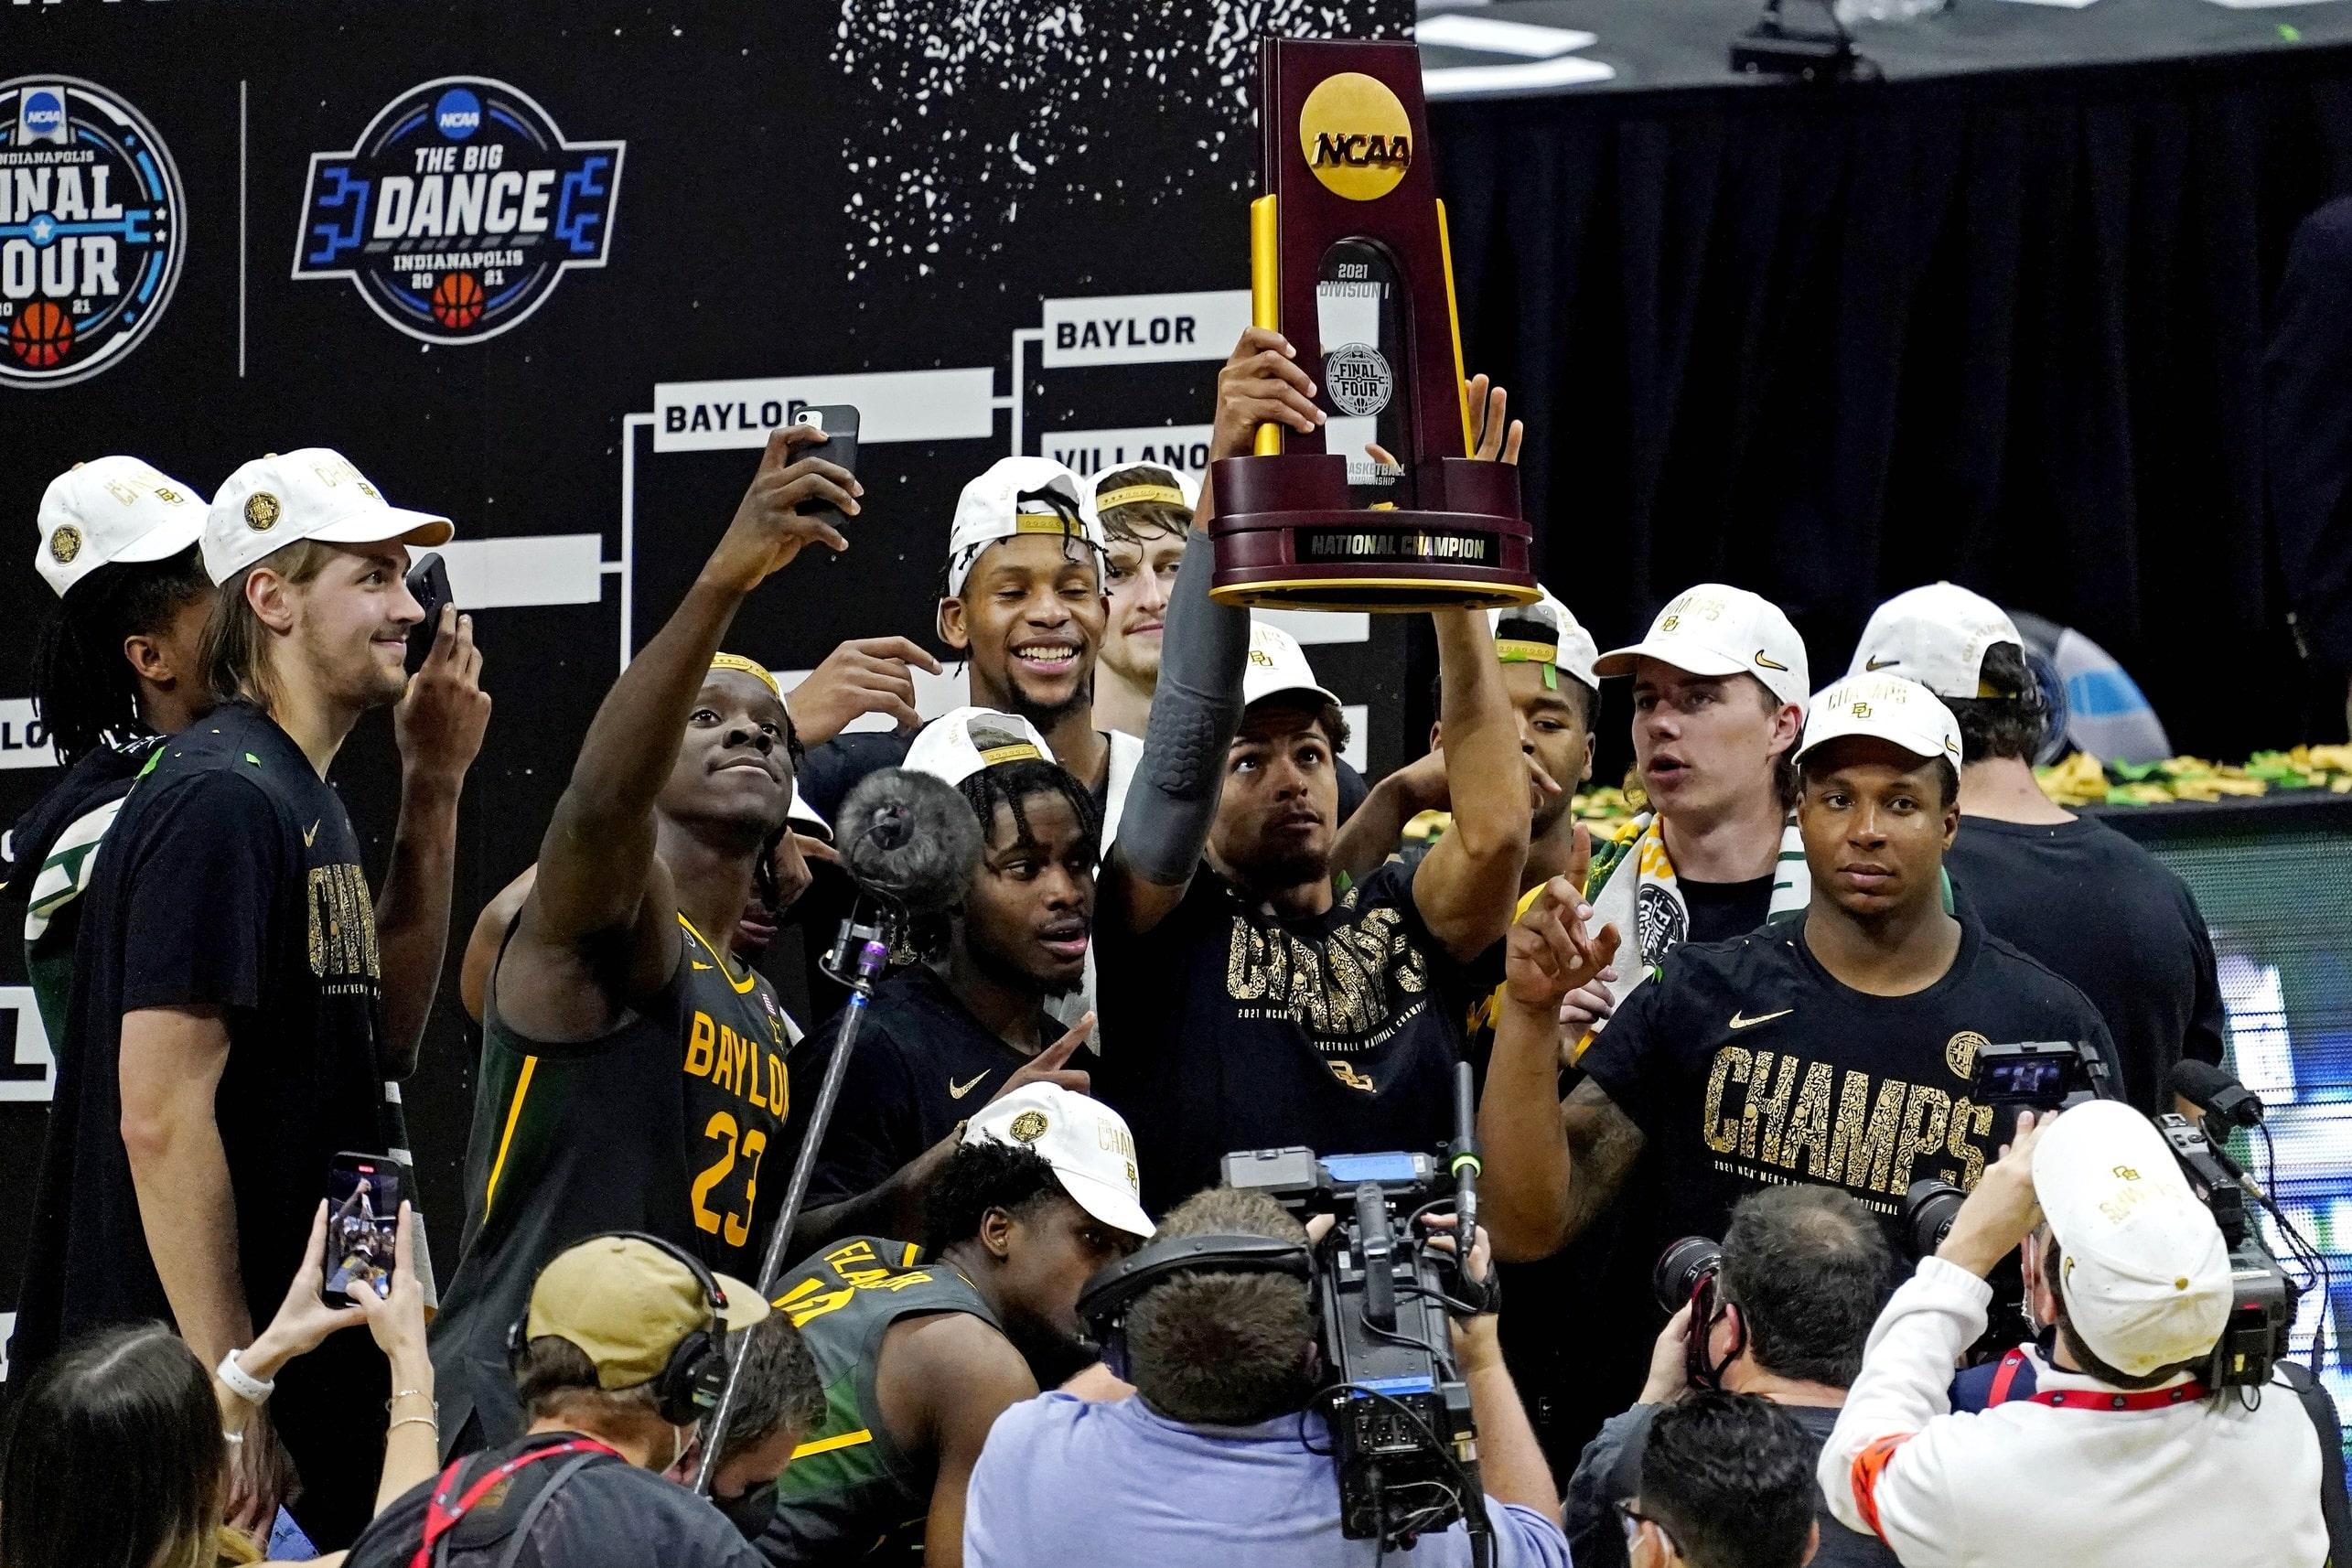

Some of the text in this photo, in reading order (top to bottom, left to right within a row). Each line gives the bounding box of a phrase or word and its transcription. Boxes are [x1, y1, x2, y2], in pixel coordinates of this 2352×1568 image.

[440, 112, 480, 128] NCAA
[414, 144, 503, 174] THE BIG
[1311, 132, 1410, 167] NCAA
[372, 169, 555, 239] DANCE
[3, 235, 120, 298] OUR
[393, 250, 524, 271] INDIANAPOLIS
[1338, 263, 1369, 279] 2021
[412, 269, 505, 289] 20 21
[1319, 280, 1381, 298] DIVISION
[1056, 316, 1196, 349] BAYLOR
[1339, 363, 1379, 379] FINAL
[1341, 381, 1379, 397] FOUR
[1348, 462, 1406, 476] ASKETBALL
[1312, 534, 1485, 560] NATIONAL CHAMPION
[1238, 1008, 1260, 1018] 2021
[1704, 1046, 1994, 1197] CHAMPS
[690, 1111, 767, 1247] 23
